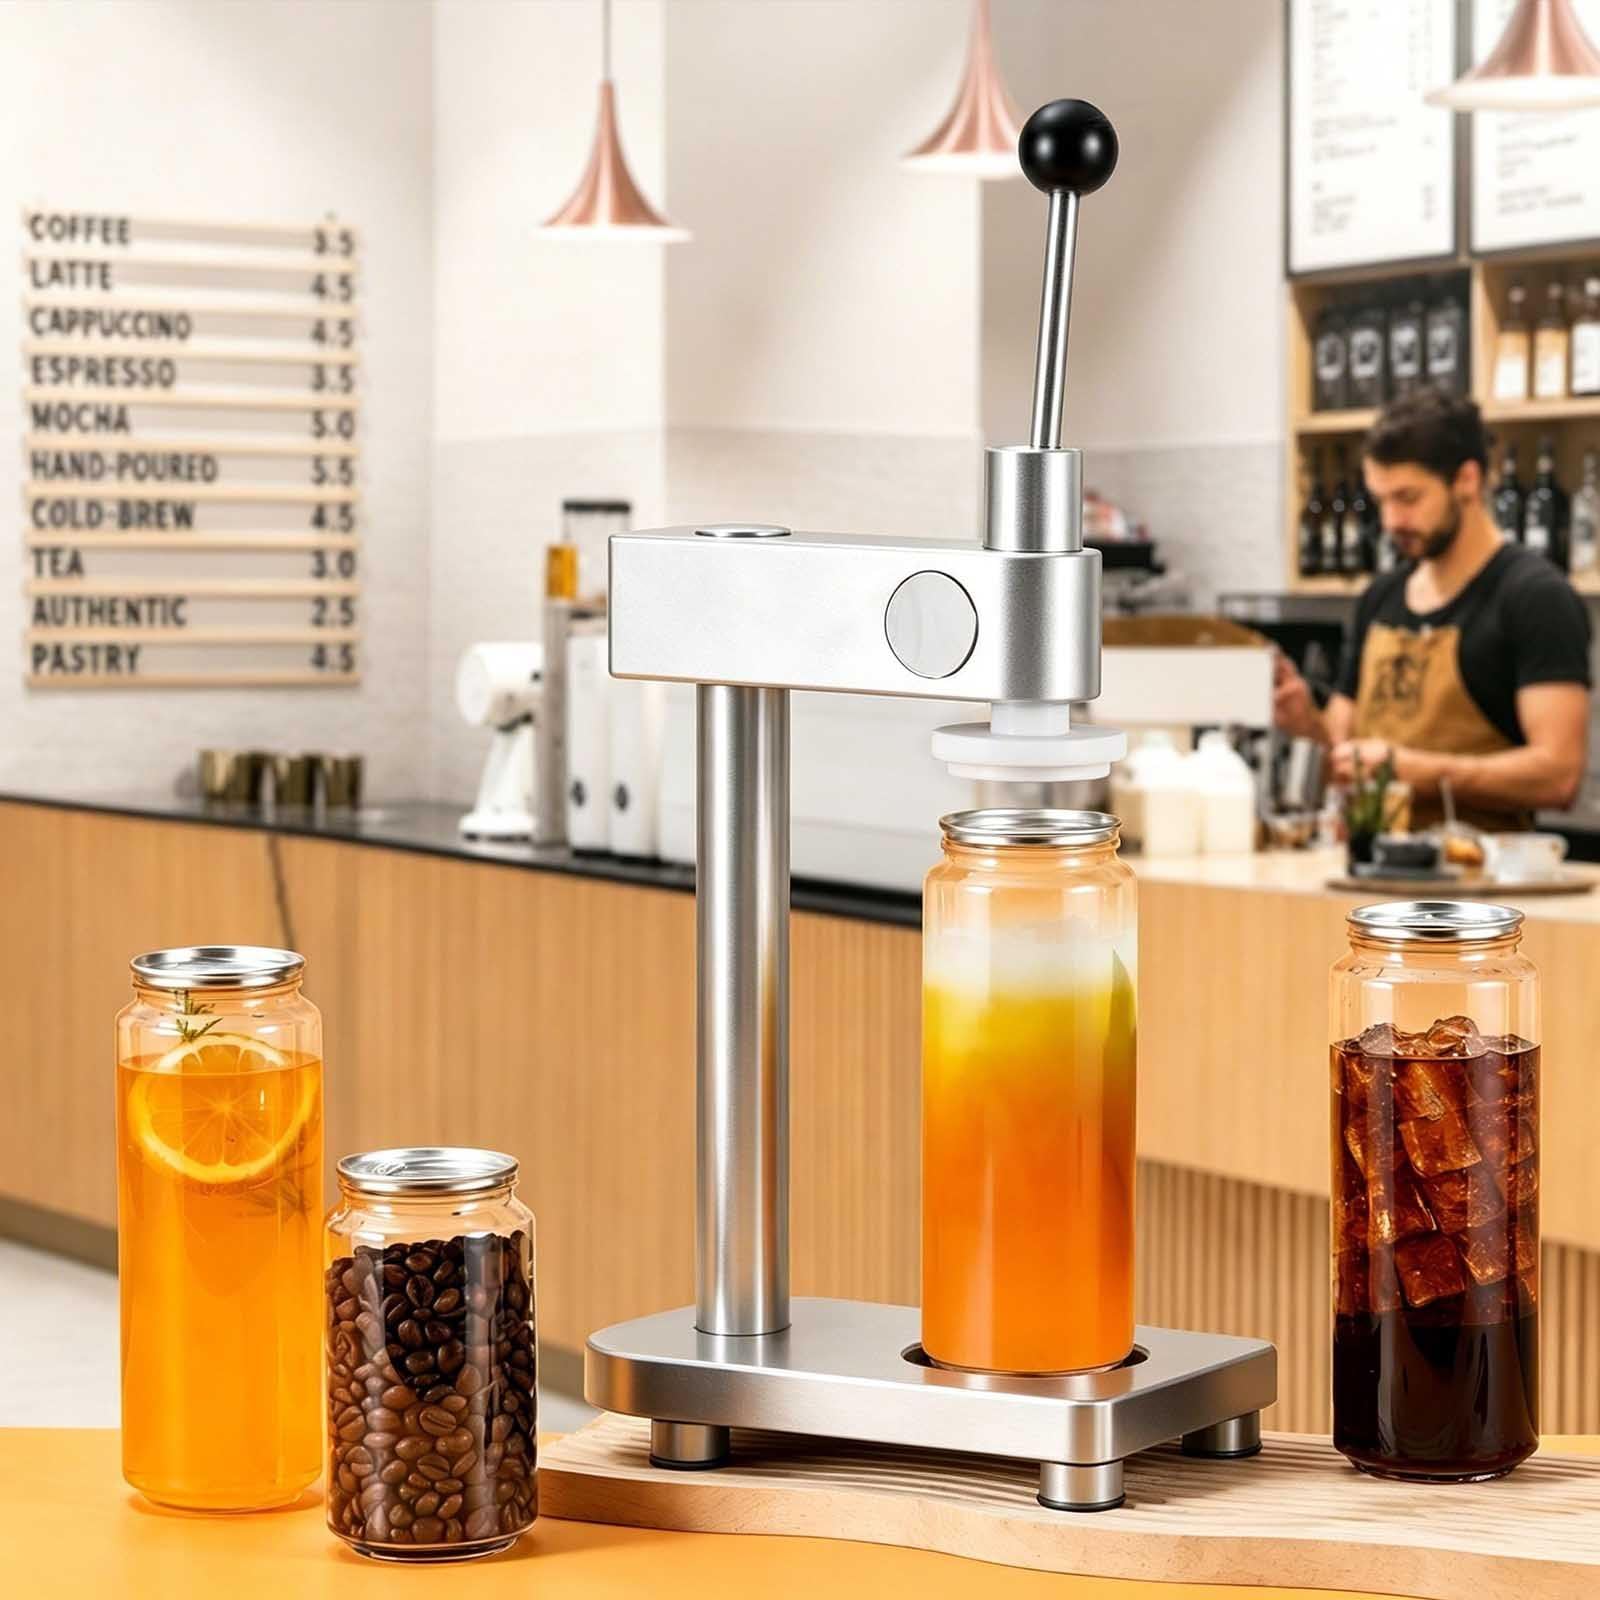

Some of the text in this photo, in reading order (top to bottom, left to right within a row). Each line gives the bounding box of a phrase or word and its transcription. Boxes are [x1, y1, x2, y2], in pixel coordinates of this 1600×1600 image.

[29, 213, 130, 245] COFFEE
[29, 259, 355, 302] LATTE 4.5
[29, 306, 355, 348] CAPPUCCINO 4.5
[31, 356, 355, 394] ESPRESSO 3.5
[31, 402, 355, 440] MOCHA 5.0
[31, 452, 355, 485] HAND-POURED 5.5
[31, 500, 355, 533] COLD-BREW 4.5
[32, 548, 356, 580] TEA 3.0
[33, 597, 355, 628] AUTHENTIC 2.5
[32, 644, 355, 674] PASTRY 4.5
